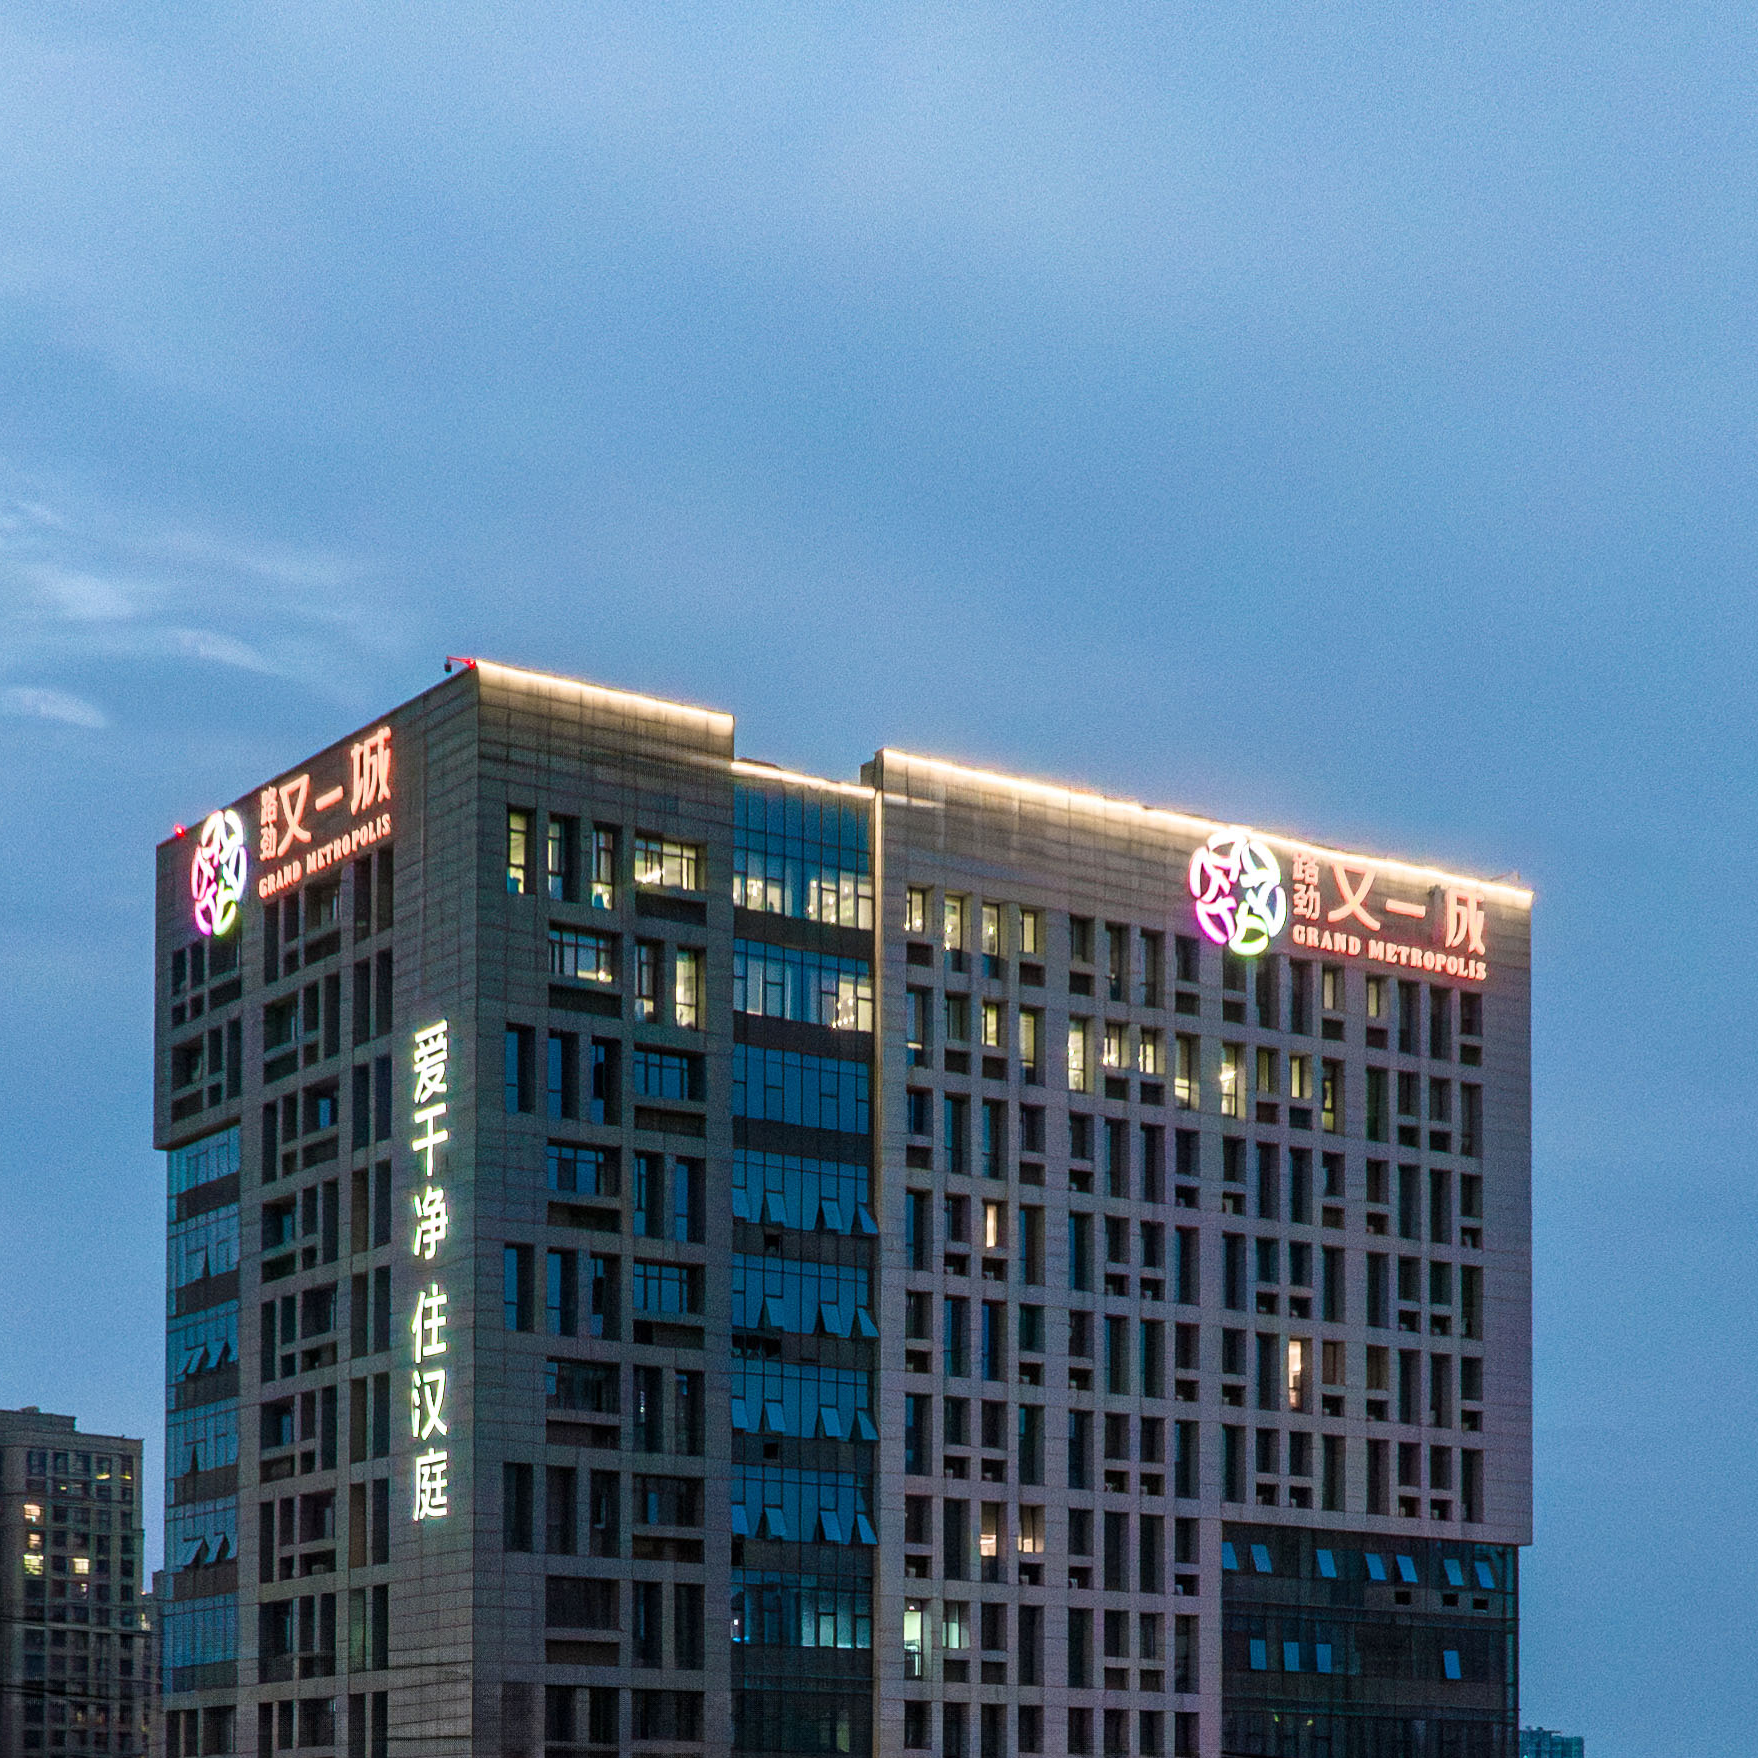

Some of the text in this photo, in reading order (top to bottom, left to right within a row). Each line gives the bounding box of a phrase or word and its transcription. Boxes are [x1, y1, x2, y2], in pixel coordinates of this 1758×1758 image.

[258, 813, 392, 899] GRAND METROPOLIS
[1292, 924, 1487, 981] GRAND METROPOLIS
